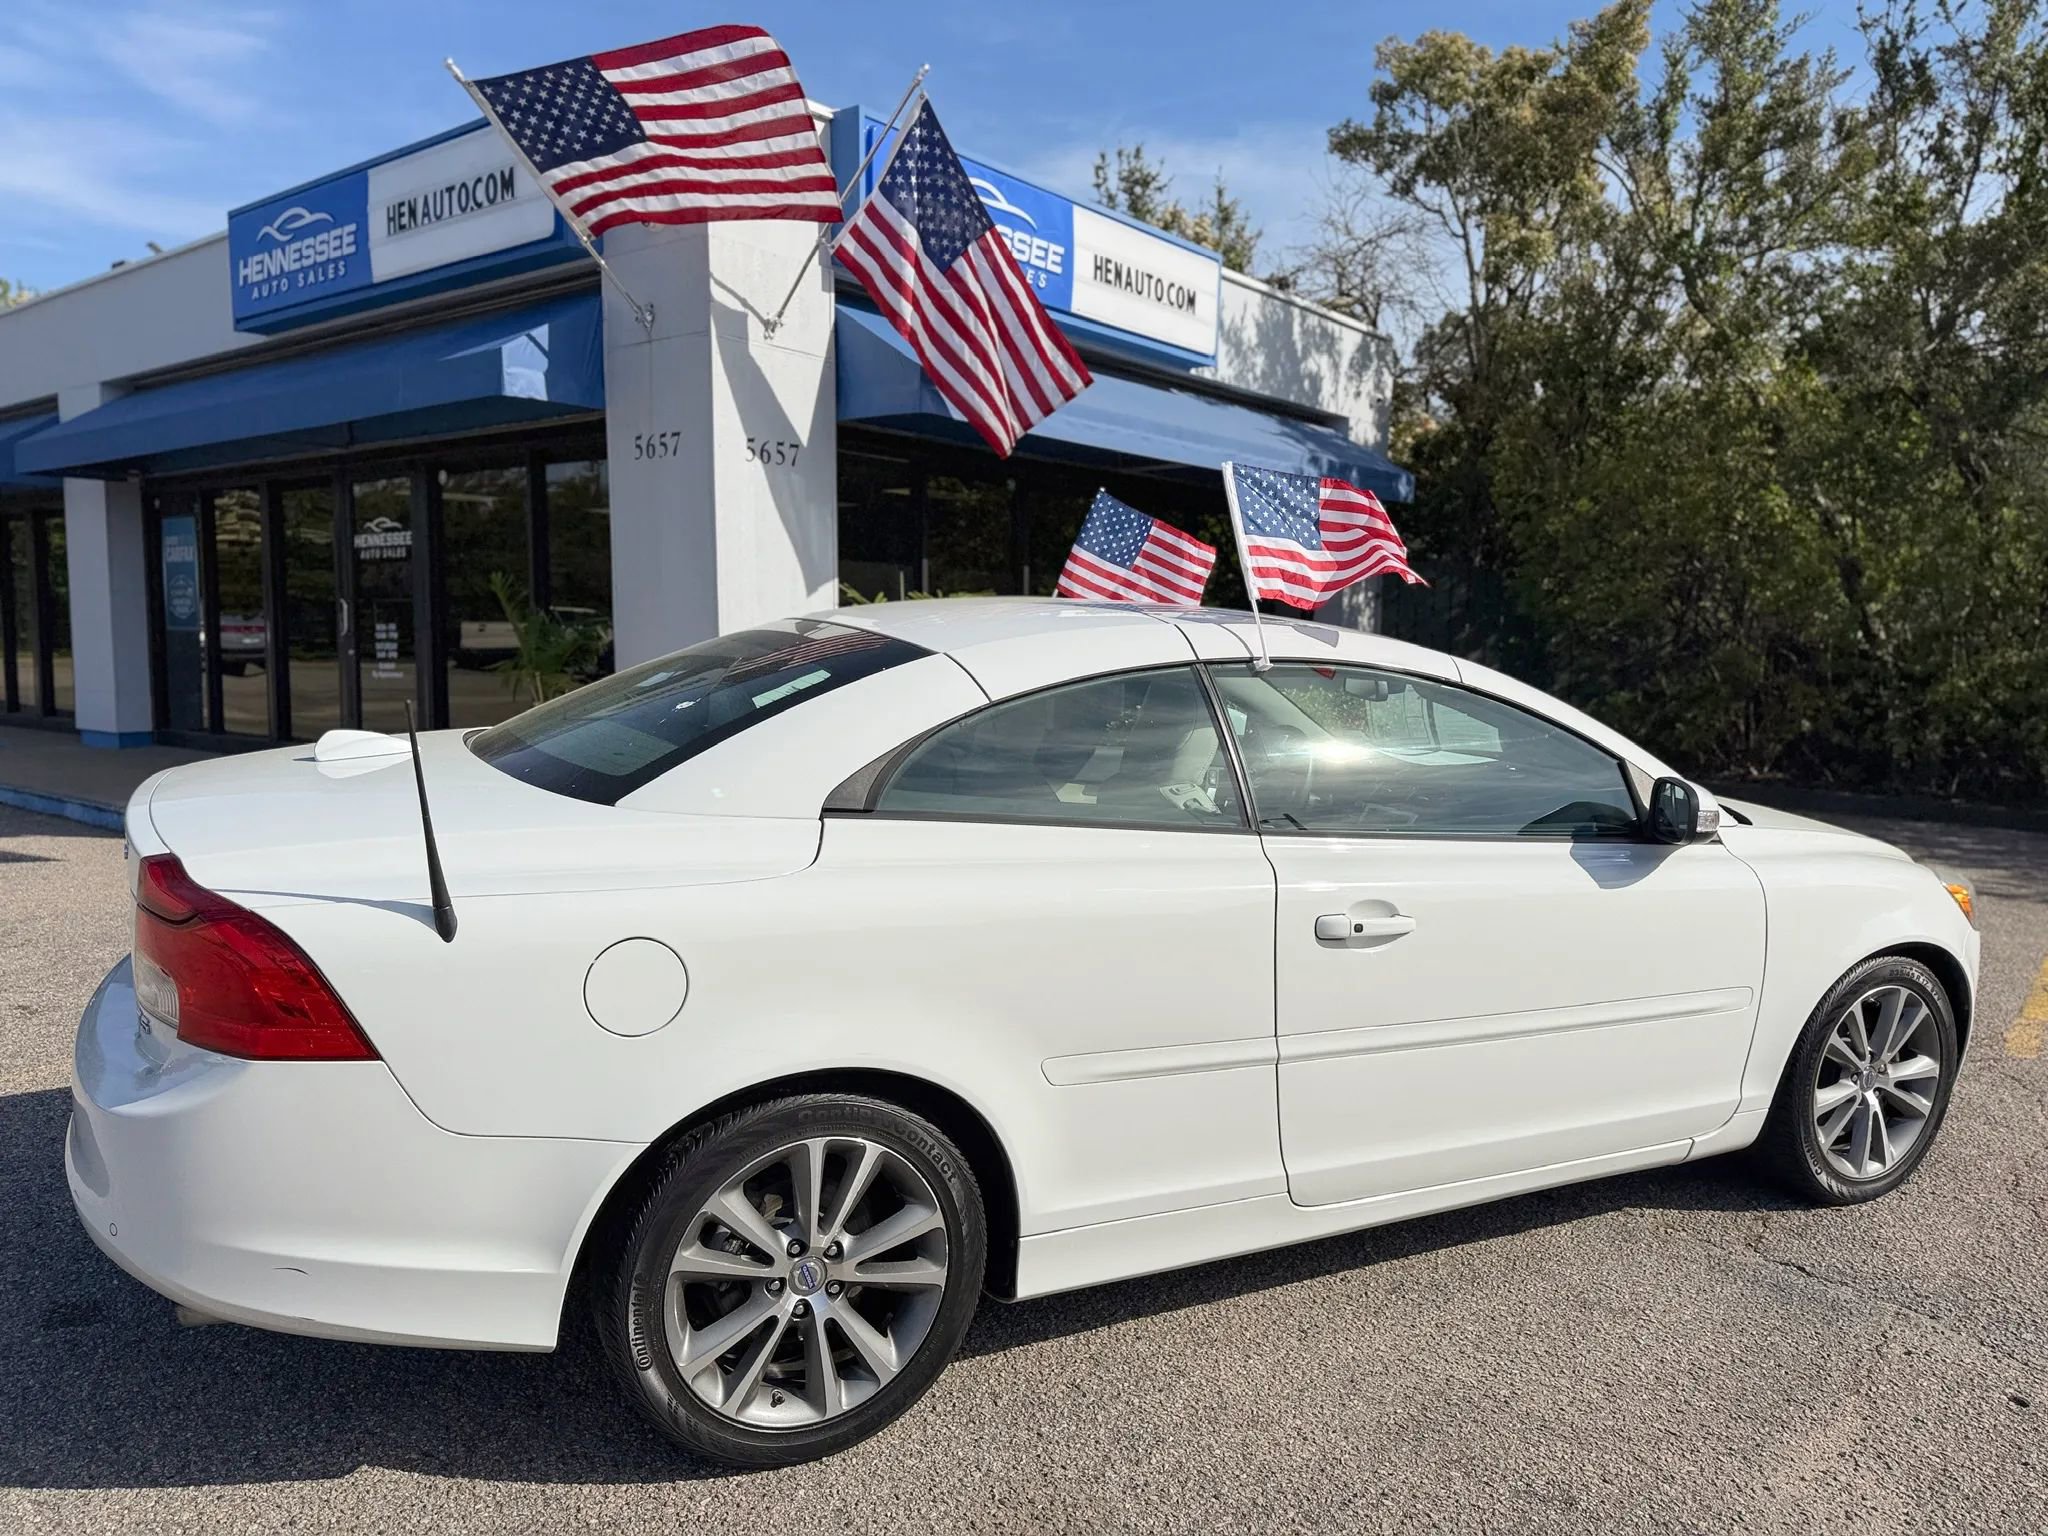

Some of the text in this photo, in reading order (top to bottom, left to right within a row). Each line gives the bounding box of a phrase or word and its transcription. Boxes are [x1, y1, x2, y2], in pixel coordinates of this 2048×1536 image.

[386, 167, 516, 237] HENAUTO.COM
[238, 223, 358, 288] HENNESSEE
[251, 261, 347, 301] AUTO SALES
[1093, 254, 1197, 315] HENAUTOCOM
[634, 431, 681, 461] 5657
[745, 437, 800, 468] 5657
[354, 530, 413, 548] HENNESSEE
[360, 547, 406, 560] AUTO SALES
